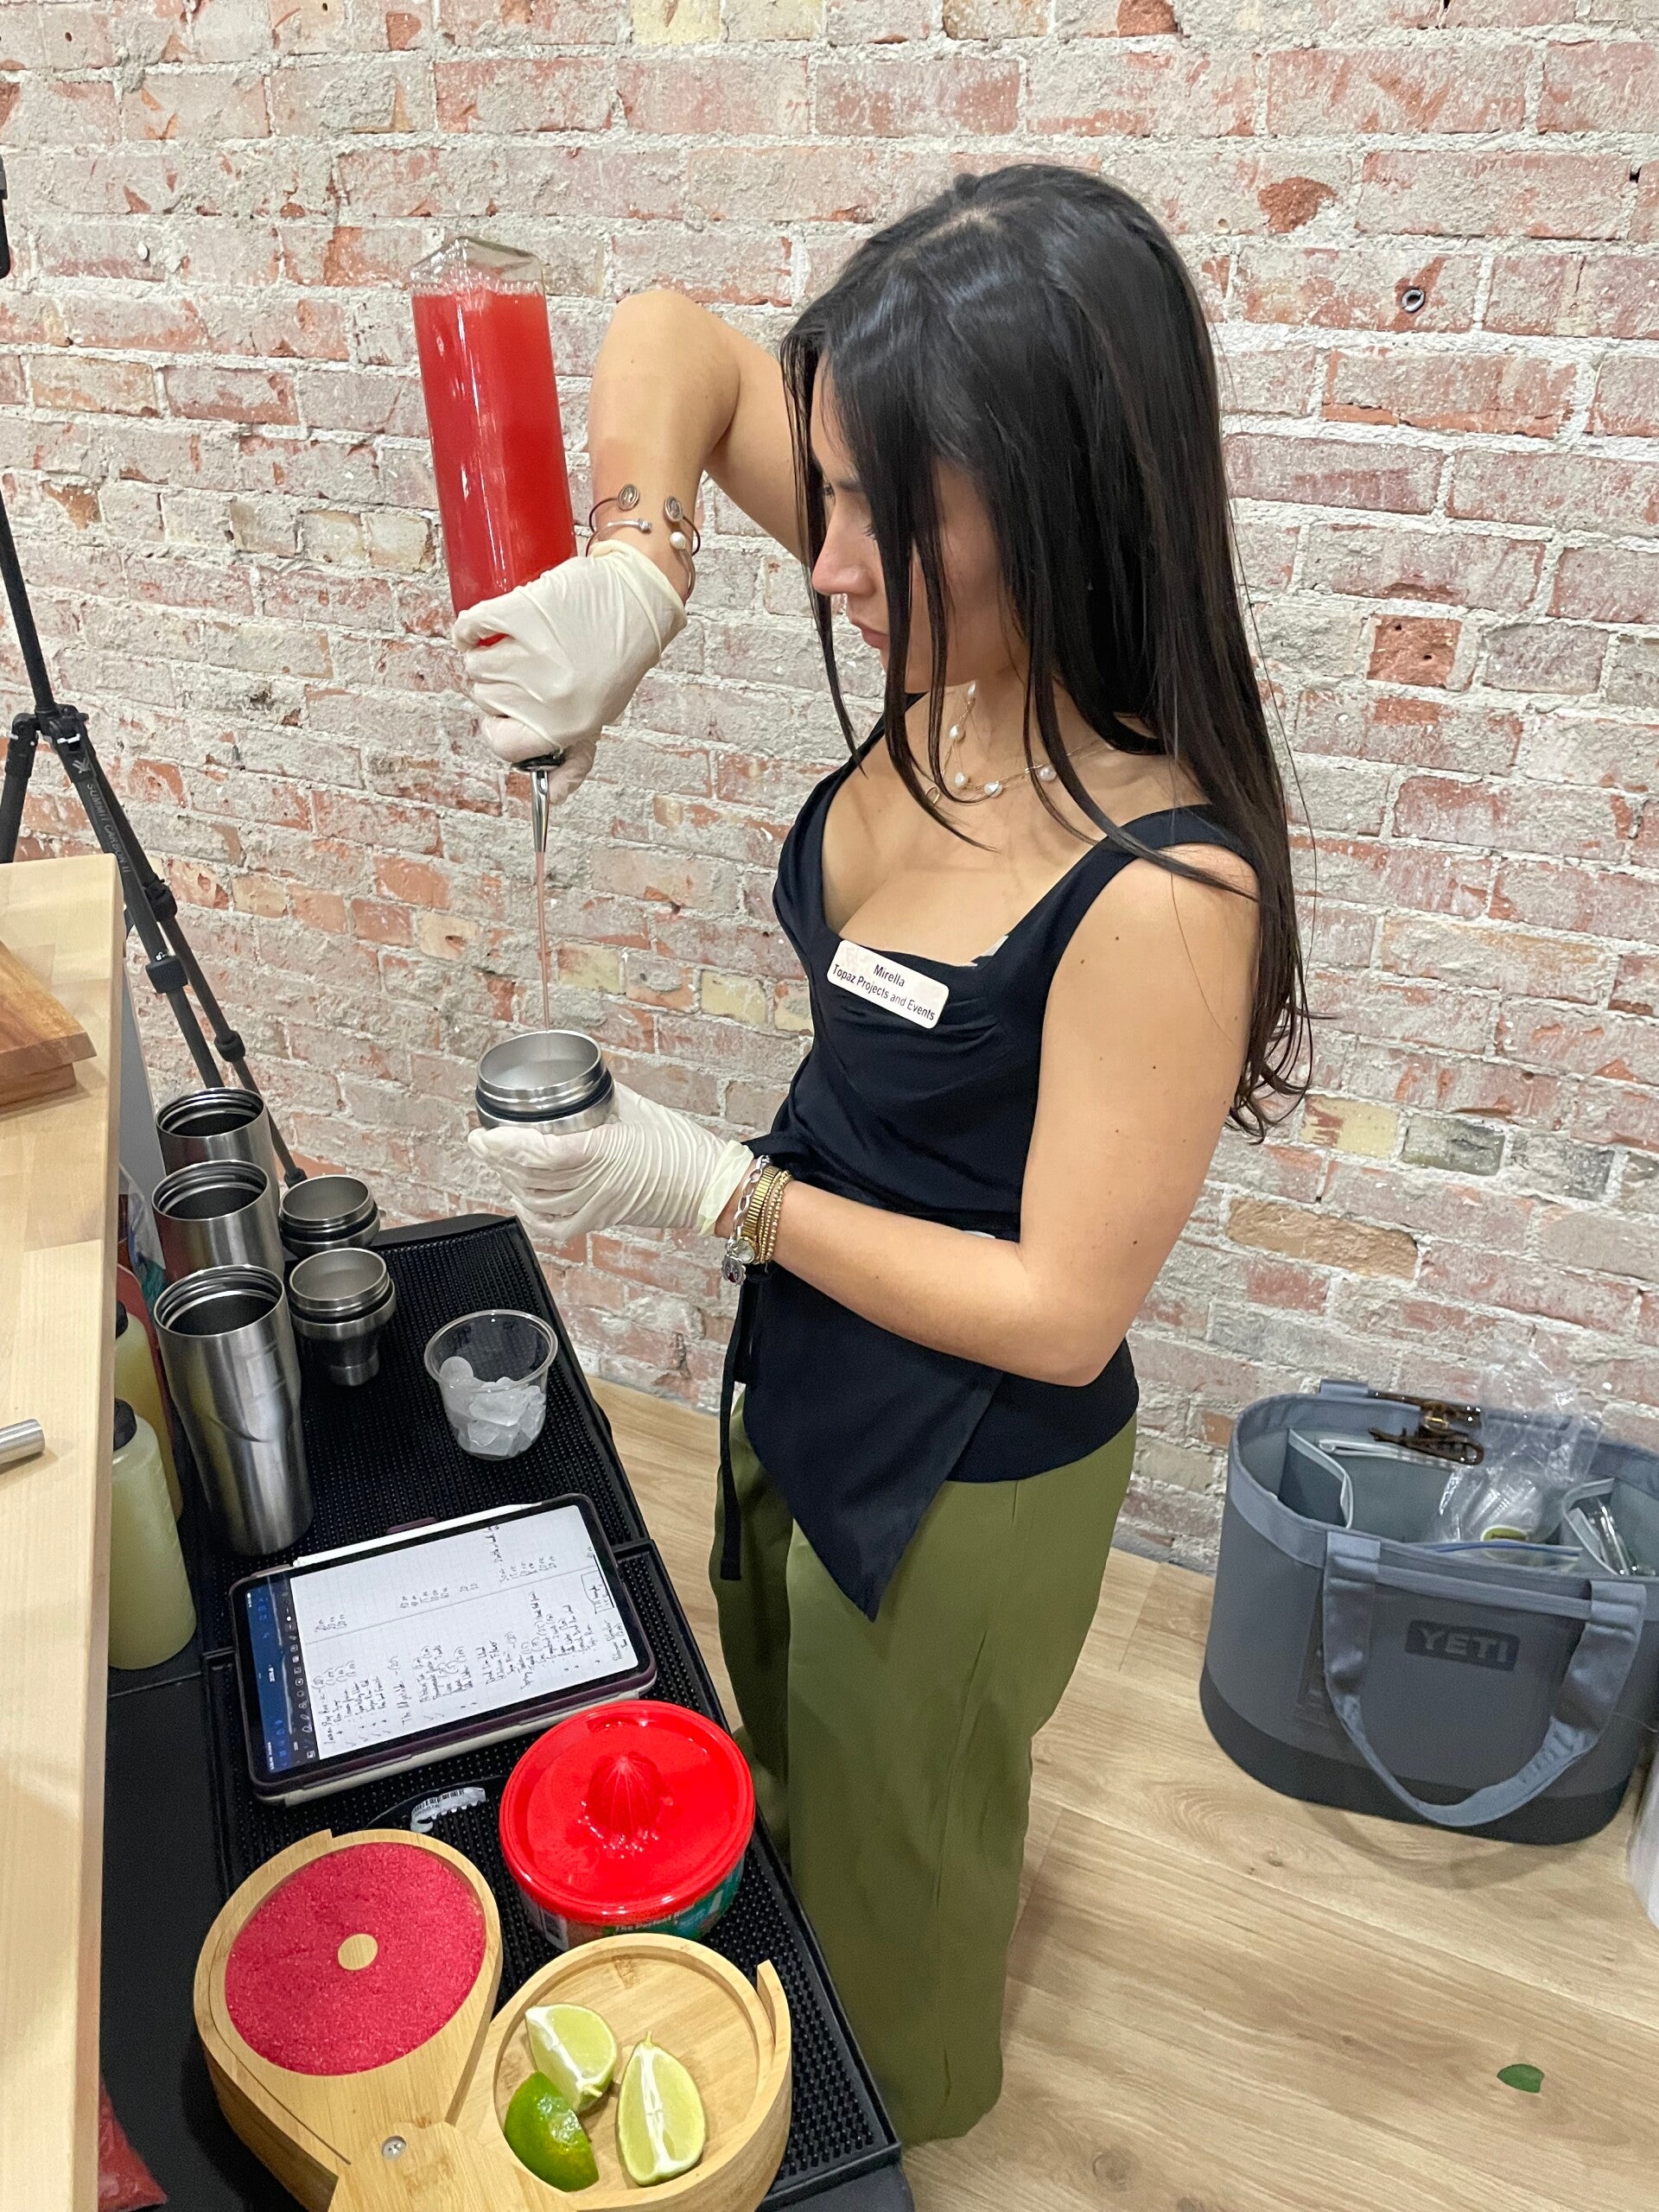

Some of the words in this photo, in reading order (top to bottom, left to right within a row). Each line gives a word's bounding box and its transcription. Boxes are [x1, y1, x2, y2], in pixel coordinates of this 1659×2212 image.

[87, 784, 108, 821] SUMMIT
[105, 824, 126, 863] CARBON
[833, 963, 855, 983] Topaz
[856, 976, 889, 999] Projects
[890, 994, 907, 1007] and
[907, 999, 935, 1020] Events
[874, 964, 905, 987] Mirella
[1418, 1628, 1507, 1662] YETI
